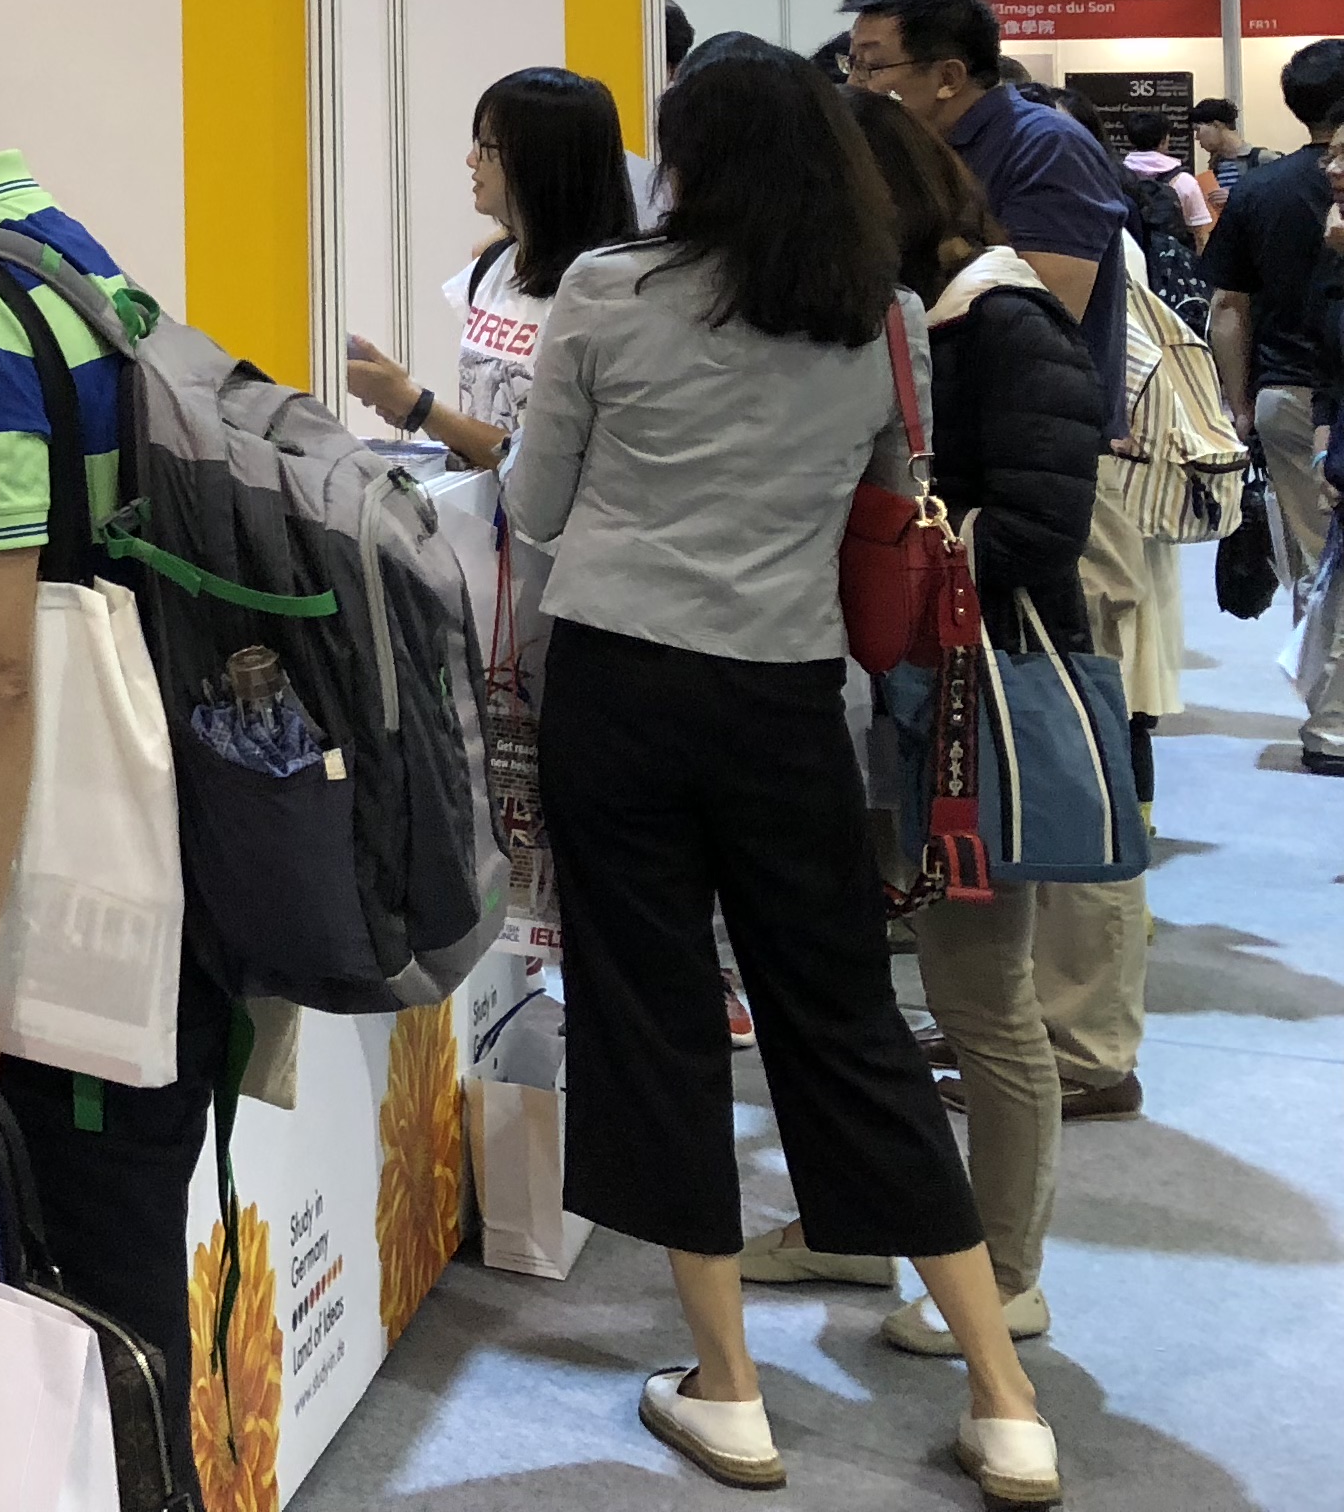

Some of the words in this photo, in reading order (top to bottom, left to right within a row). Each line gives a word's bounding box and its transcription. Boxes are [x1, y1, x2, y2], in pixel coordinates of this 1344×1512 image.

[1048, 2, 1062, 14] et
[1065, 1, 1085, 14] du
[1088, 1, 1115, 13] Son
[290, 1198, 314, 1248] Study
[315, 1188, 324, 1219] in
[291, 1229, 330, 1289] Germany
[293, 1324, 314, 1376] Land
[314, 1310, 323, 1349] of
[324, 1295, 345, 1337] Ideas
